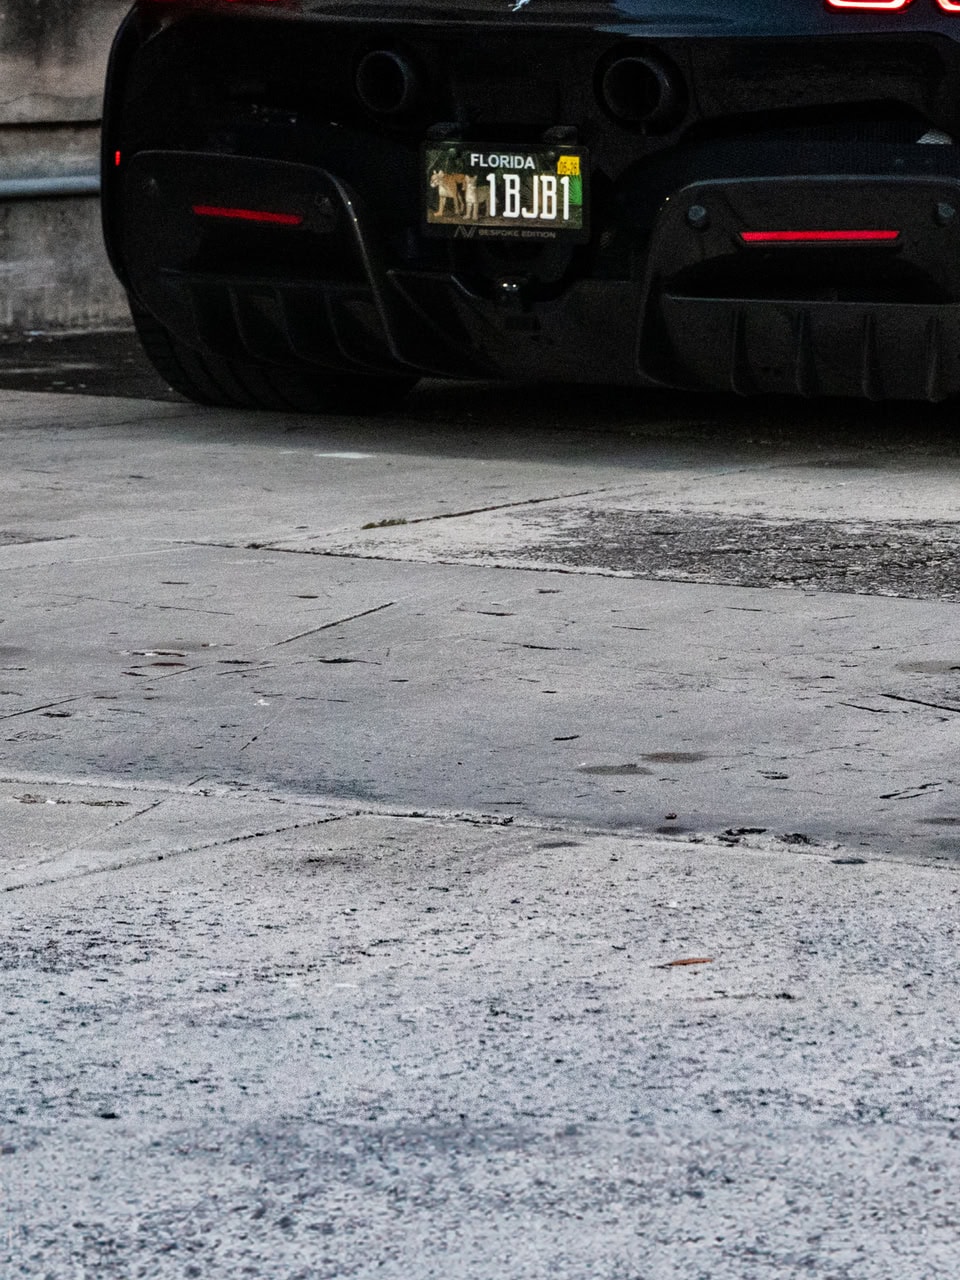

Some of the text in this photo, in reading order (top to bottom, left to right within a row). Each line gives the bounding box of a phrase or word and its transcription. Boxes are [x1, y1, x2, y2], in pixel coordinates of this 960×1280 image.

[470, 153, 536, 170] FLORIDA
[486, 173, 570, 221] 1BJB1
[521, 230, 557, 239] EDITION
